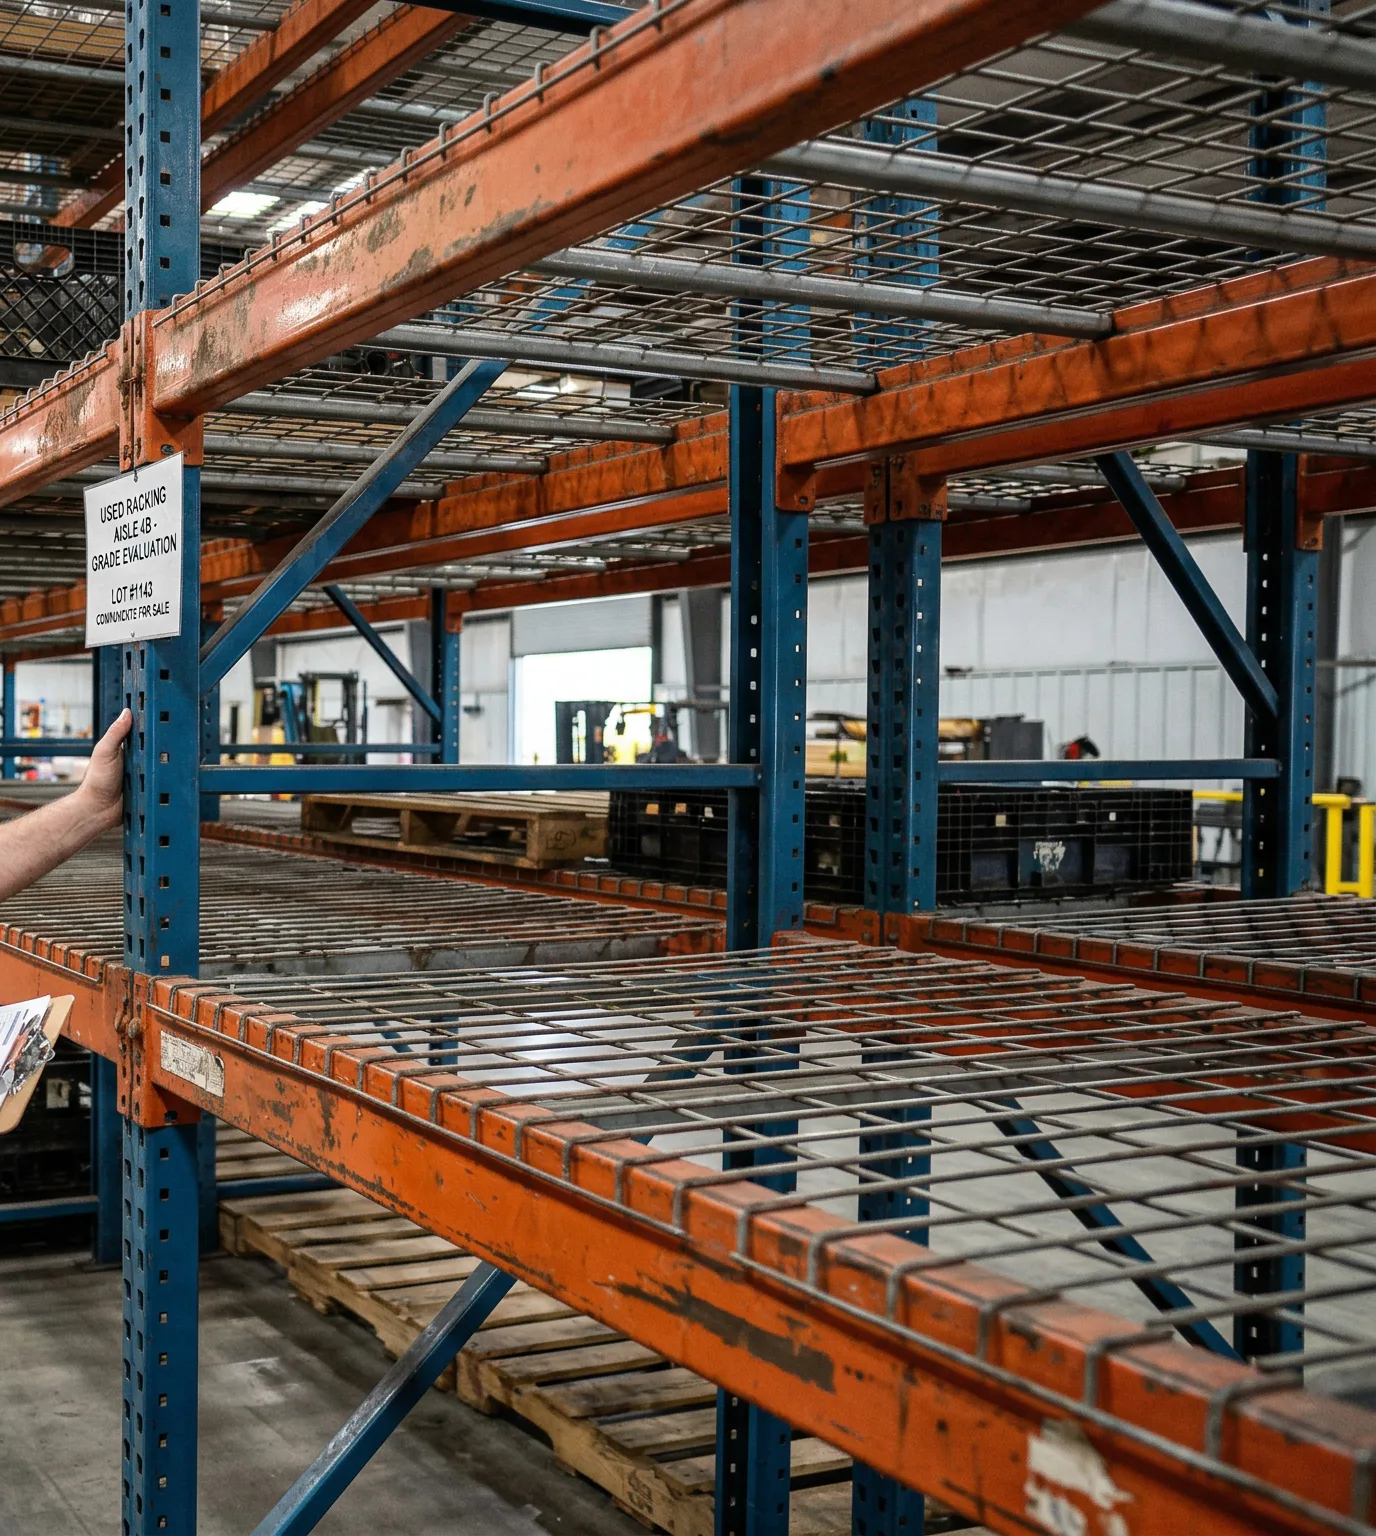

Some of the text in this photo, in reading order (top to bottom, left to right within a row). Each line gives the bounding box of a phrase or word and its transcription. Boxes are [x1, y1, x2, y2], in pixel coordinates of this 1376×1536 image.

[100, 485, 166, 523] USED RACKING
[113, 520, 138, 543] AISLE
[140, 516, 151, 534] 4B
[91, 532, 176, 571] GRADE EVALUATION
[111, 586, 128, 604] LOT
[152, 601, 169, 616] SALE
